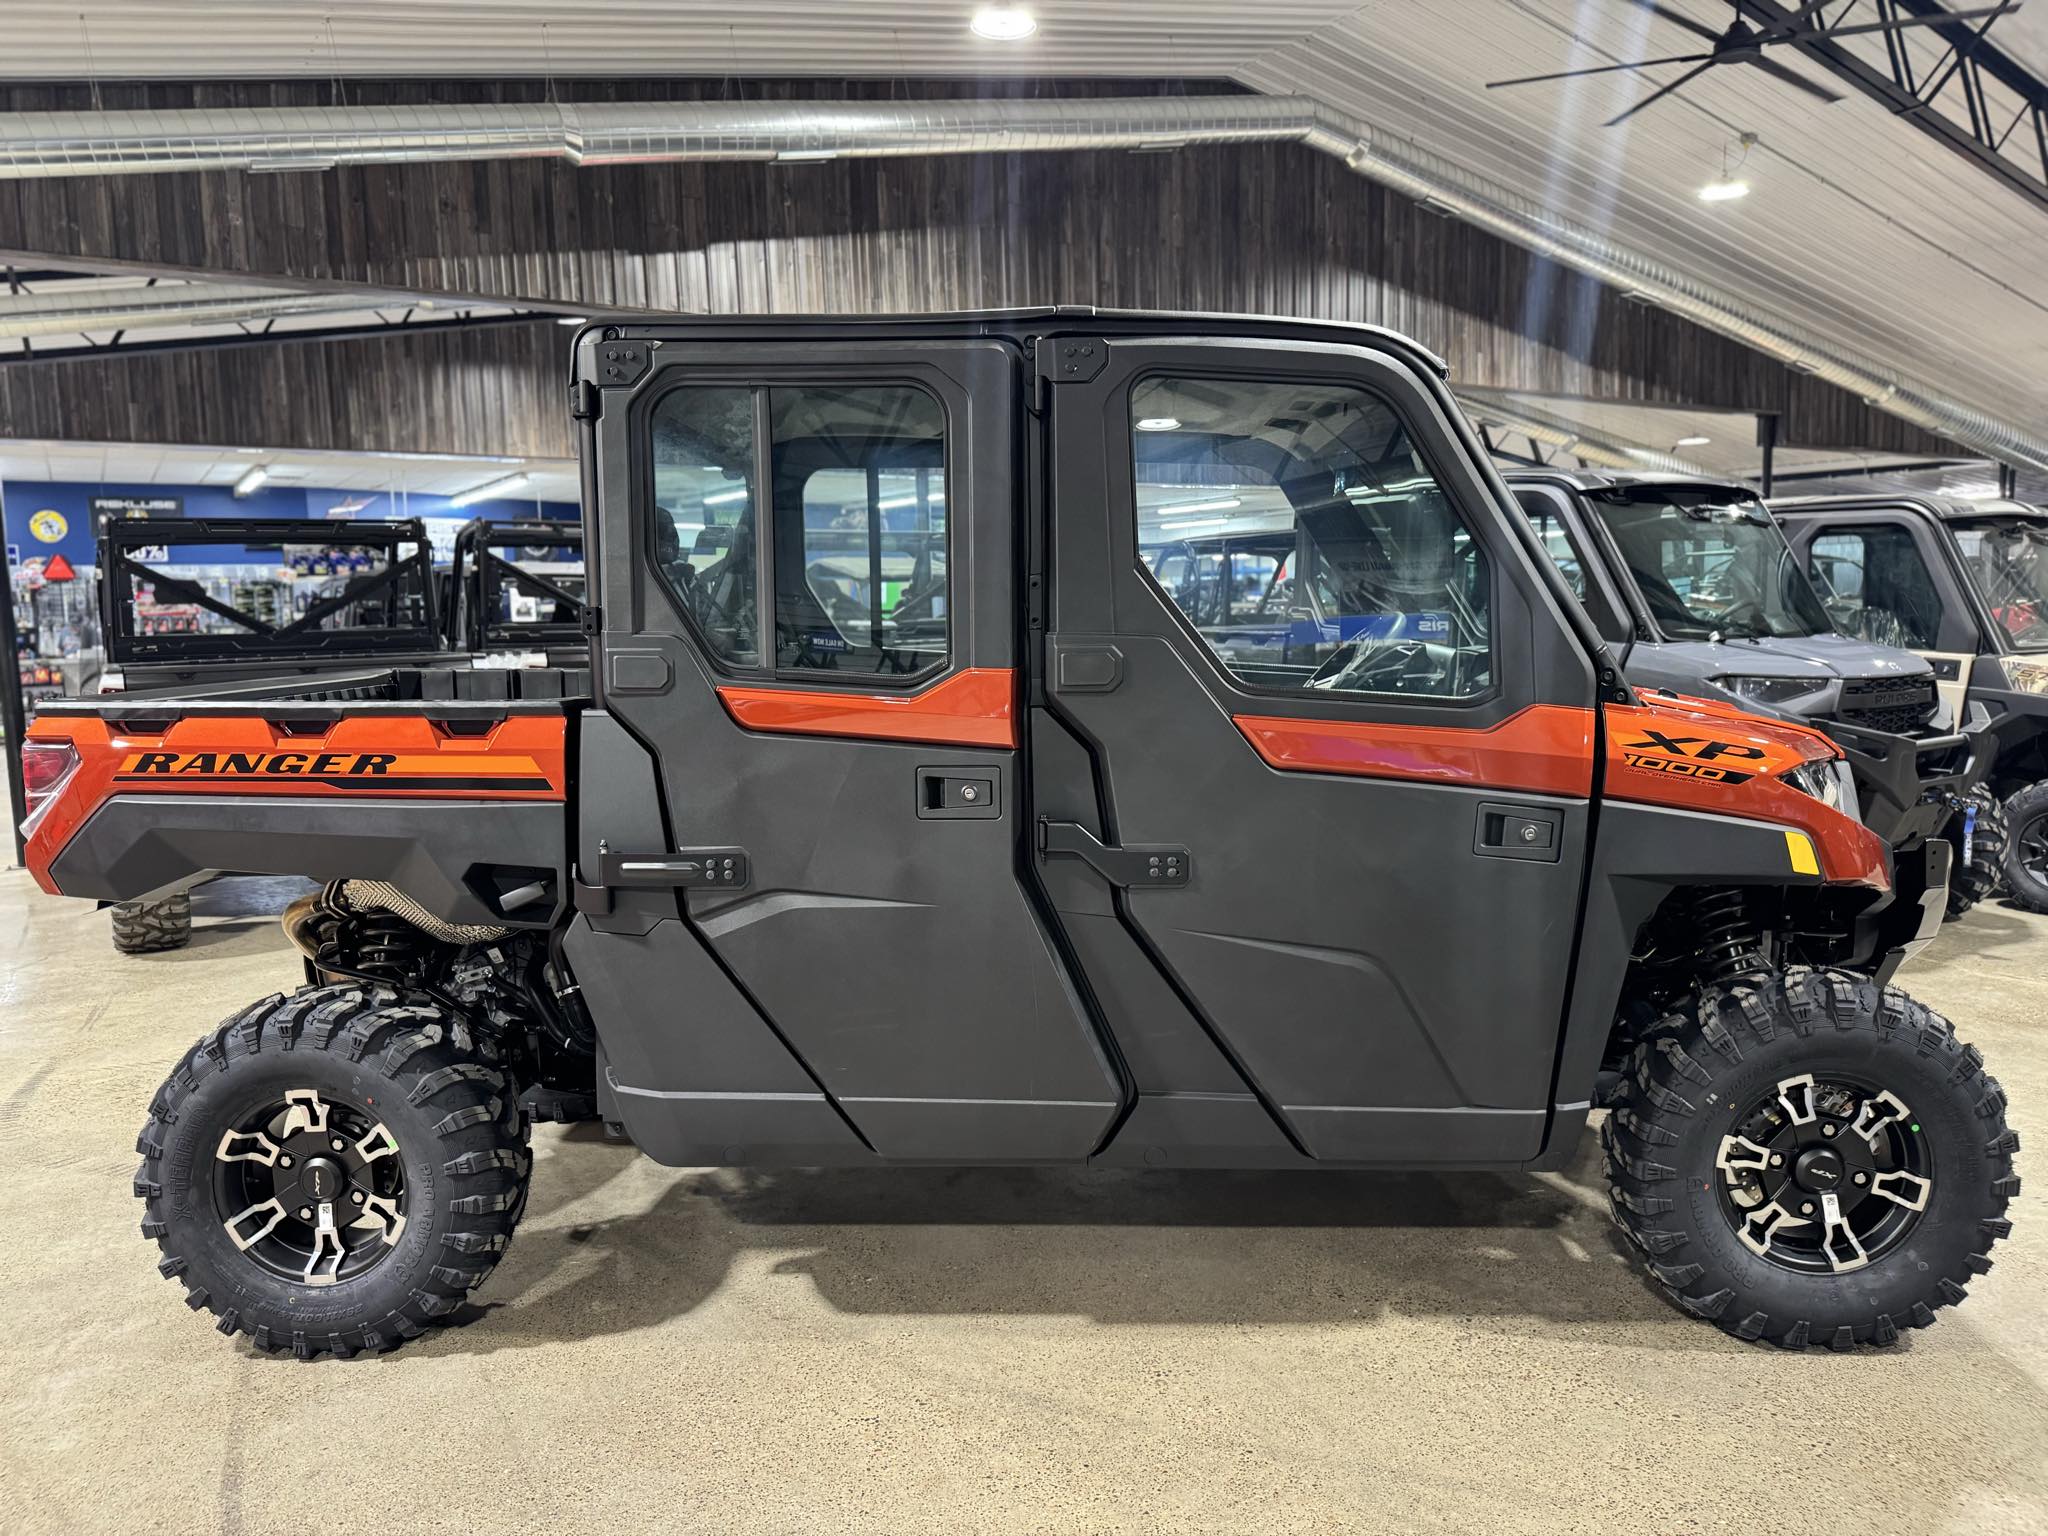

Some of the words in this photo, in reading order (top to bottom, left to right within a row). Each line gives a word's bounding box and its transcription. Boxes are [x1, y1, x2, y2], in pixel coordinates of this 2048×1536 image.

[1621, 729, 1766, 761] XP
[131, 753, 397, 775] RANGER
[1624, 754, 1727, 781] 1000
[417, 1162, 435, 1200] PRO
